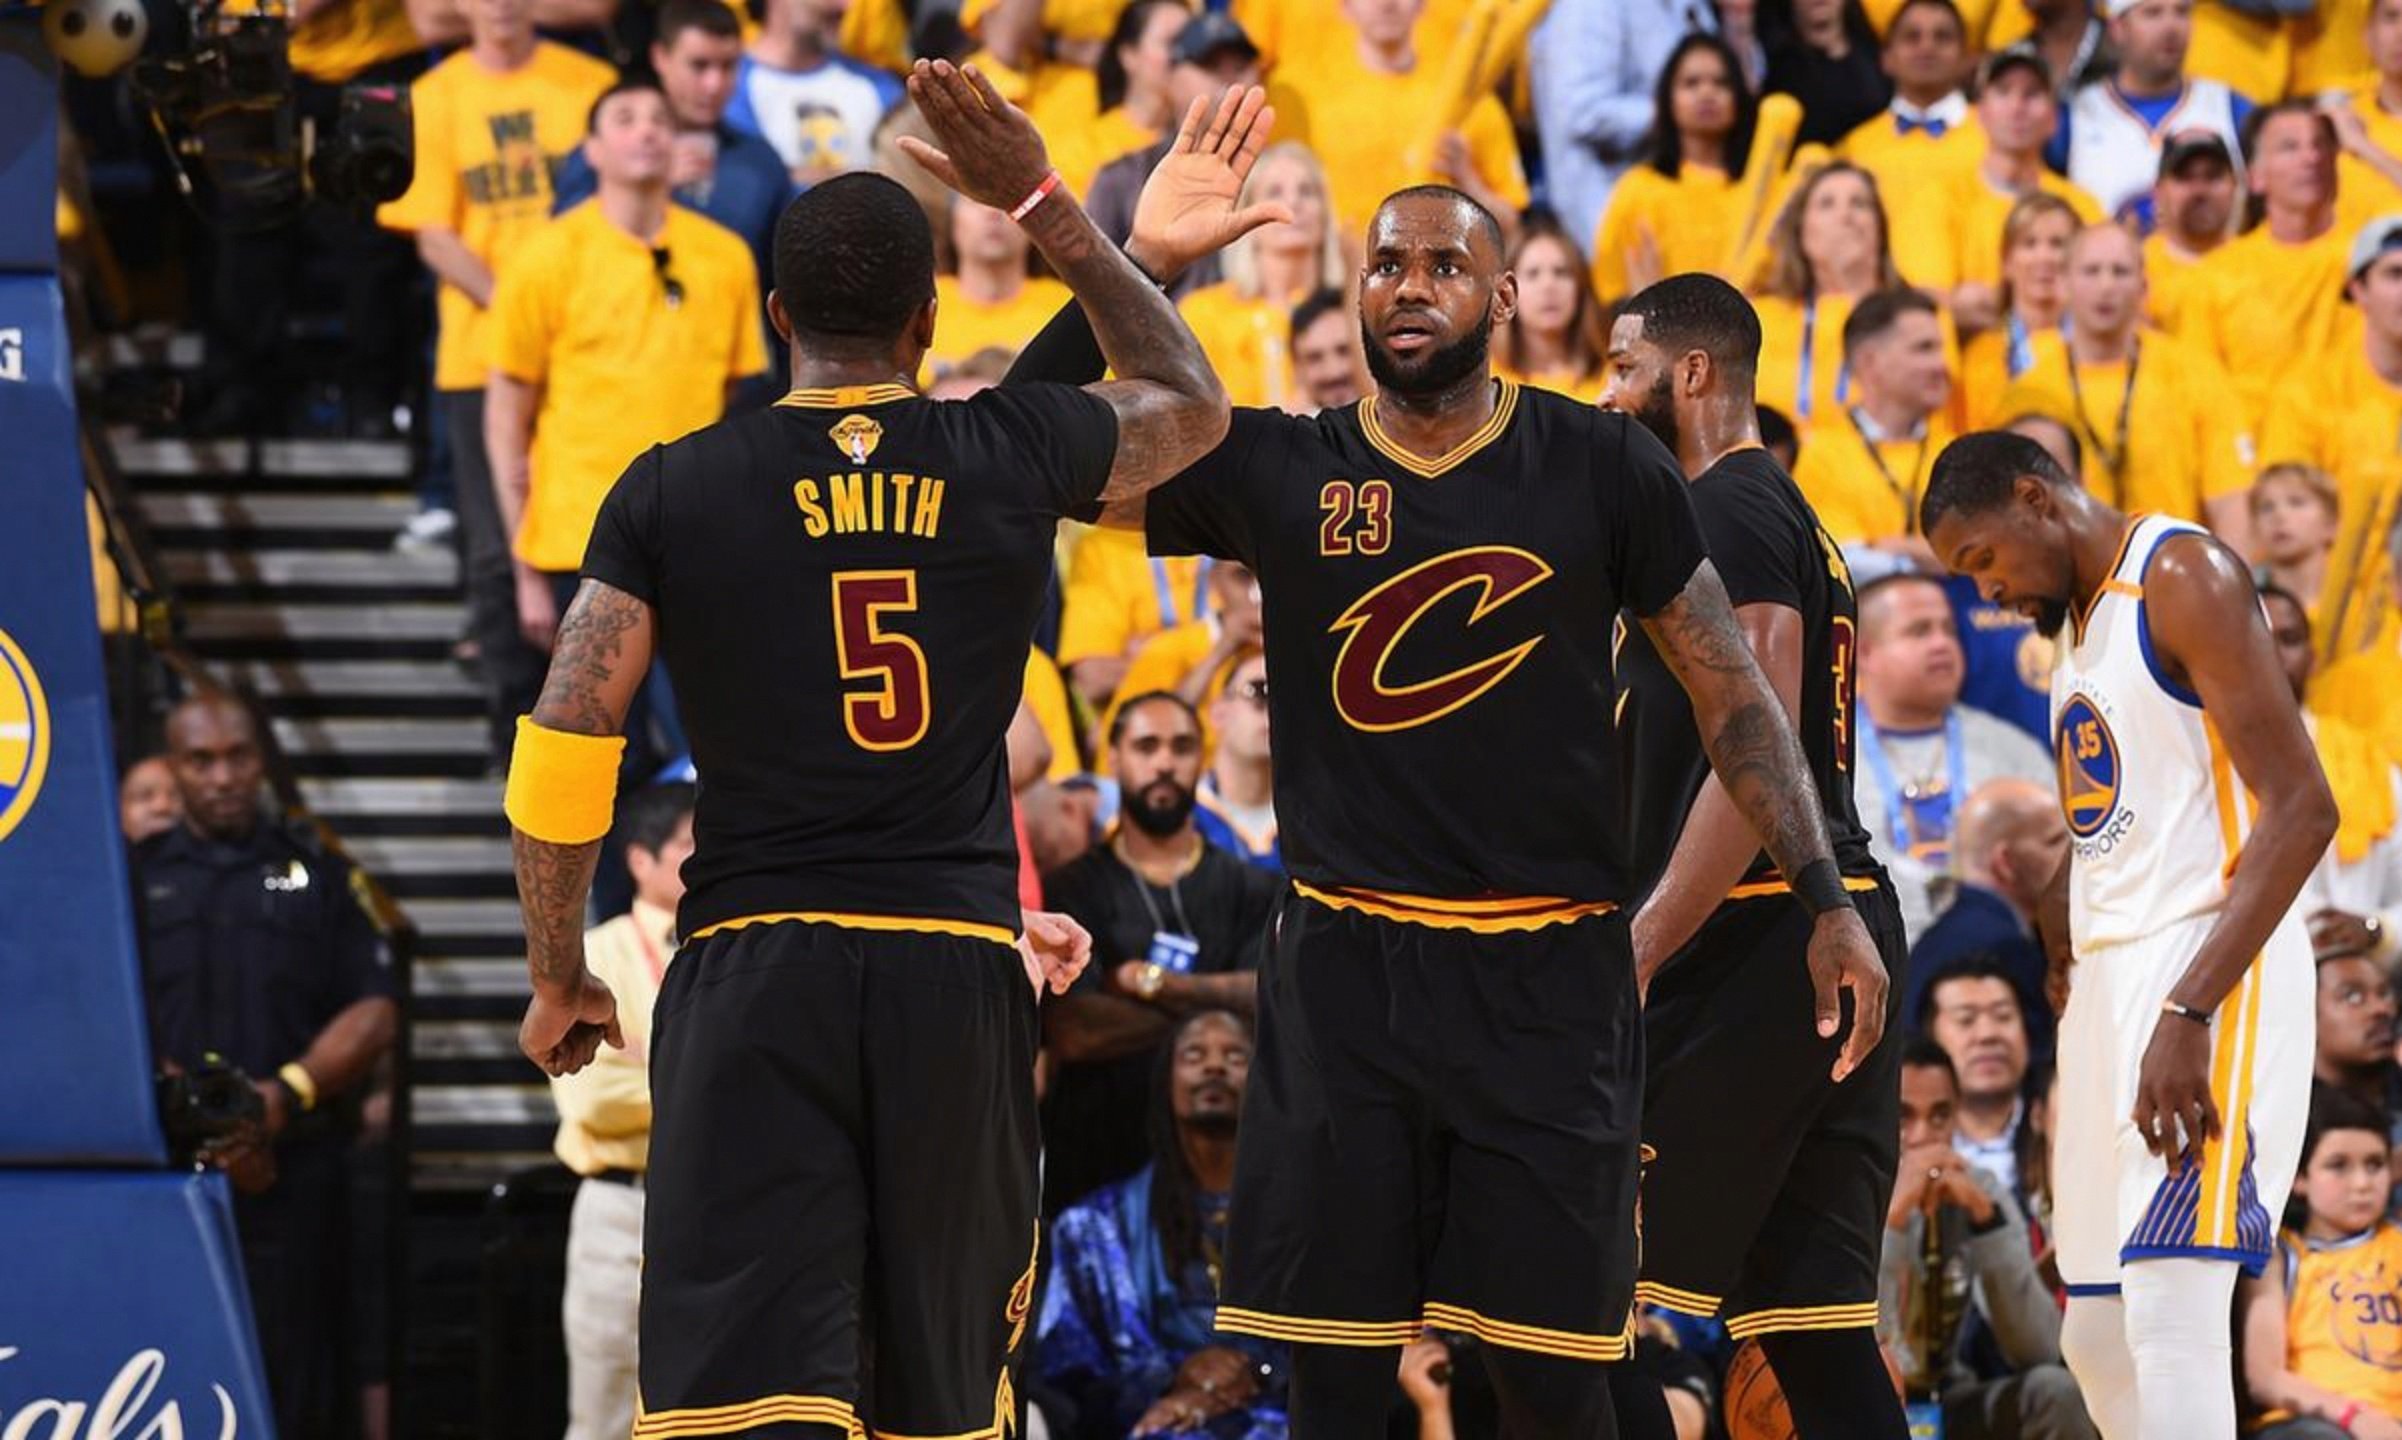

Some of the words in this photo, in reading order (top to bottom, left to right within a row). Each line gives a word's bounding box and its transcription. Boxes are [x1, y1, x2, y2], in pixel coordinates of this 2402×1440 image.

[794, 472, 945, 538] SMITH
[1320, 480, 1392, 556] 23
[832, 569, 931, 751] 5
[2353, 1293, 2402, 1325] 30
